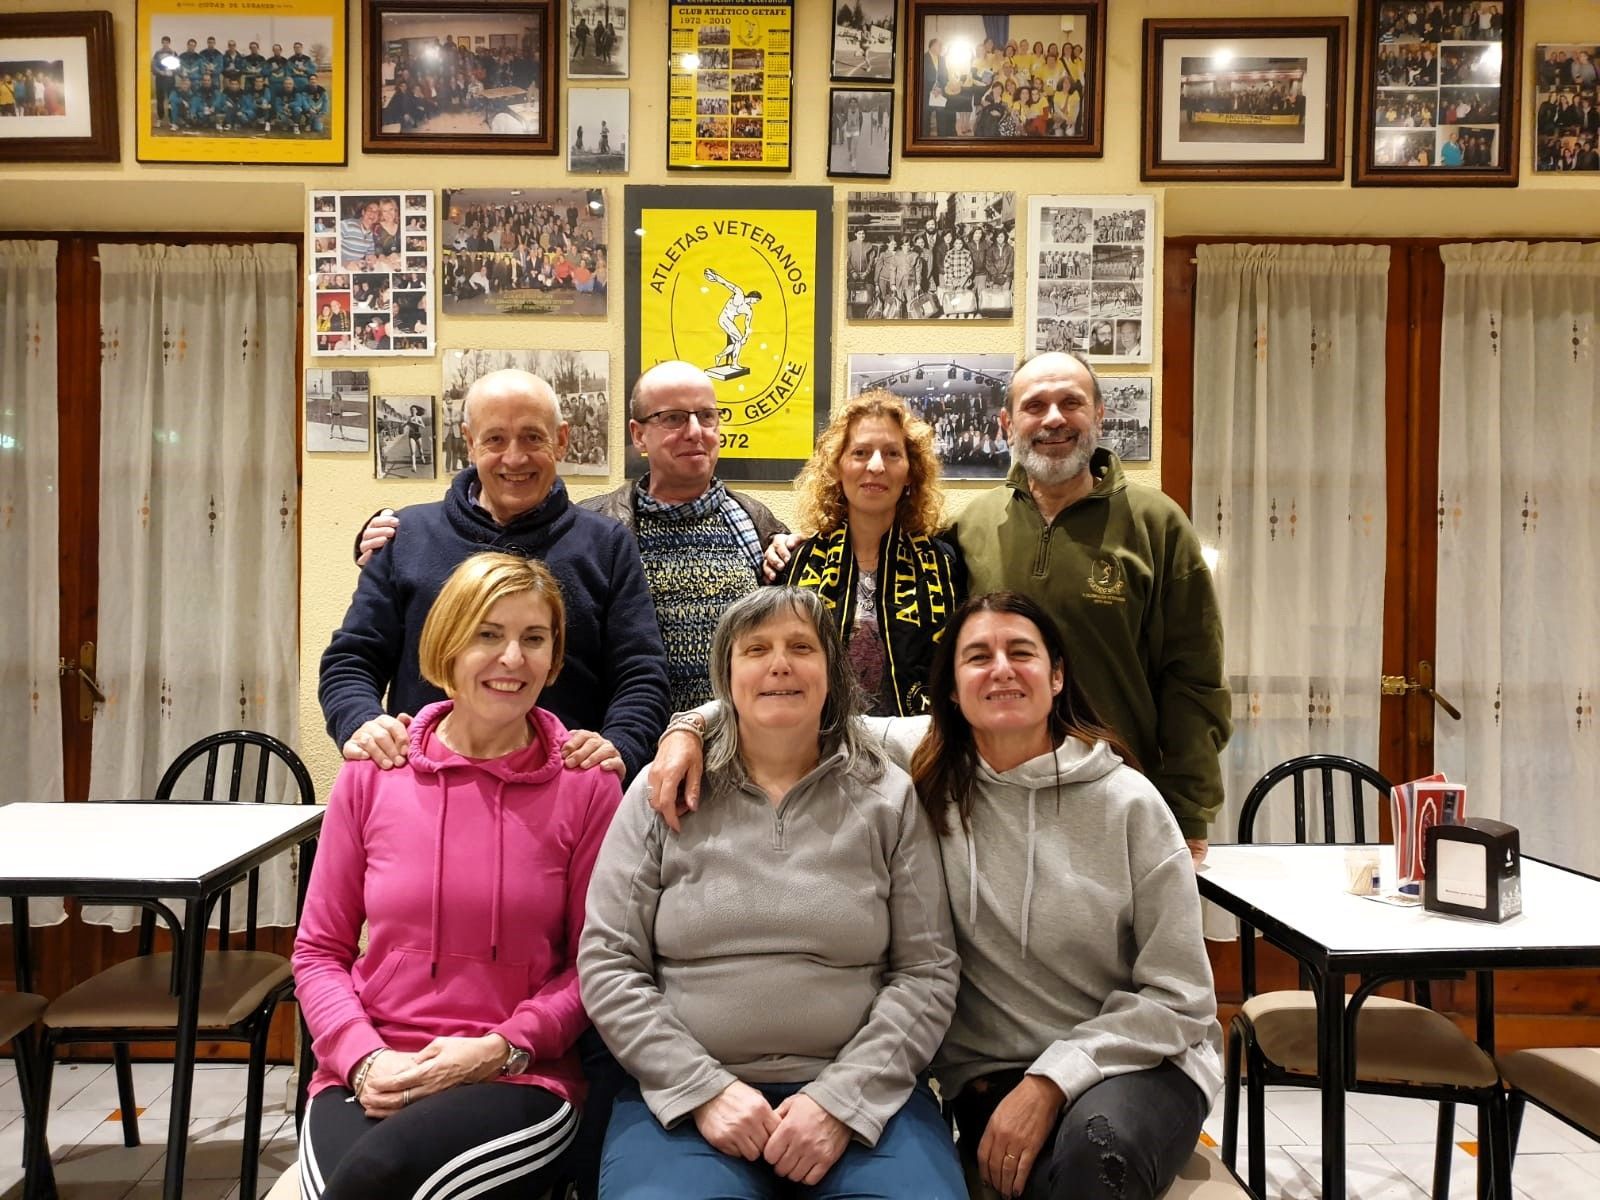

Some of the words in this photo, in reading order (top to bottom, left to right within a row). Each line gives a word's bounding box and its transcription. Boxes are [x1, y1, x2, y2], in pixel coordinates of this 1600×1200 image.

[704, 7, 749, 15] ATLÉTICO
[650, 225, 709, 294] ATLETAS
[713, 220, 806, 295] VETERANOS
[744, 361, 802, 420] GETAFE
[719, 434, 749, 449] 972
